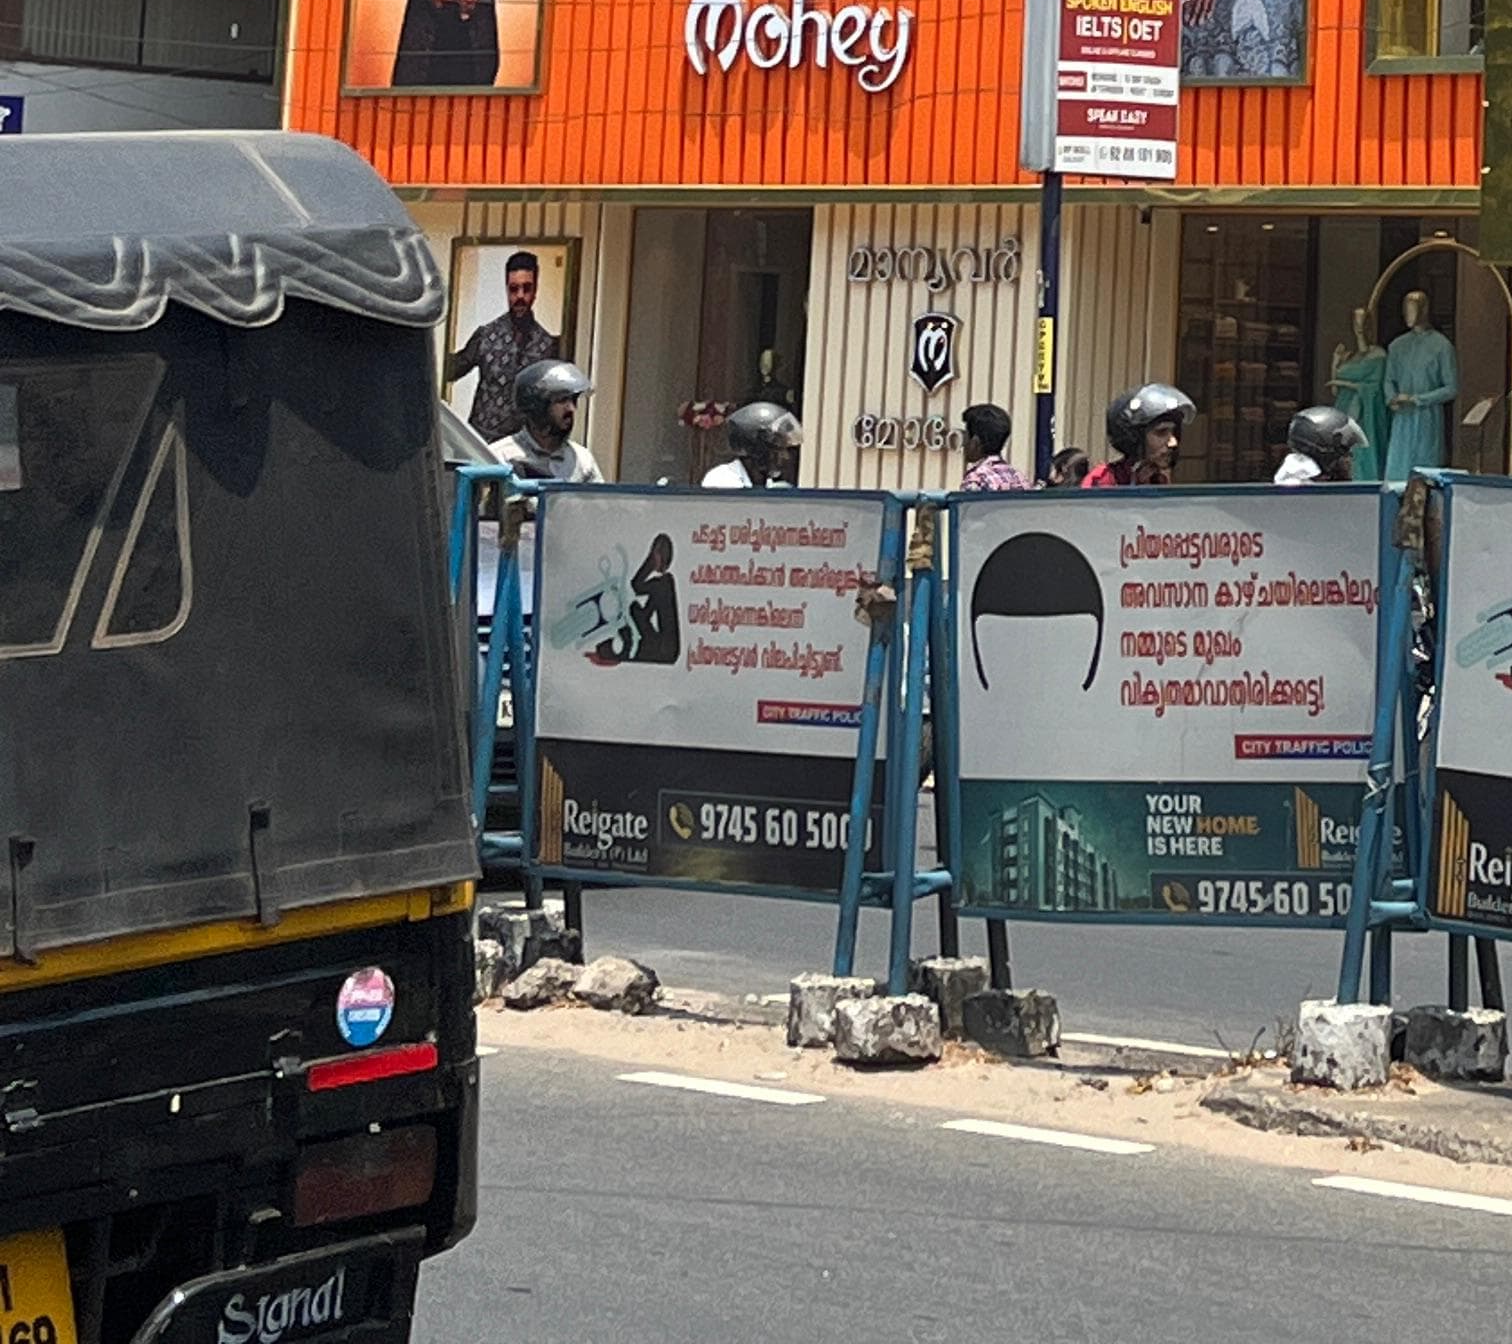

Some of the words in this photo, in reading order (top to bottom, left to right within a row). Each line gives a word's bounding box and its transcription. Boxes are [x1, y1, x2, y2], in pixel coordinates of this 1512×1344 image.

[1076, 15, 1122, 38] IELTS
[1129, 18, 1163, 41] OET
[1242, 740, 1272, 755] CITY
[1275, 741, 1330, 756] TRAFFIC
[1333, 741, 1373, 756] POLIC
[1146, 794, 1202, 814] YOUR
[564, 798, 648, 851] Reigate
[701, 804, 757, 844] 9745
[766, 811, 797, 846] 60
[806, 813, 872, 852] 500
[1147, 816, 1195, 835] NEW
[1197, 816, 1261, 835] HOME
[1147, 837, 1167, 856] IS
[1170, 838, 1223, 856] HERE
[1199, 880, 1263, 913] 9745
[1273, 881, 1309, 915] 60
